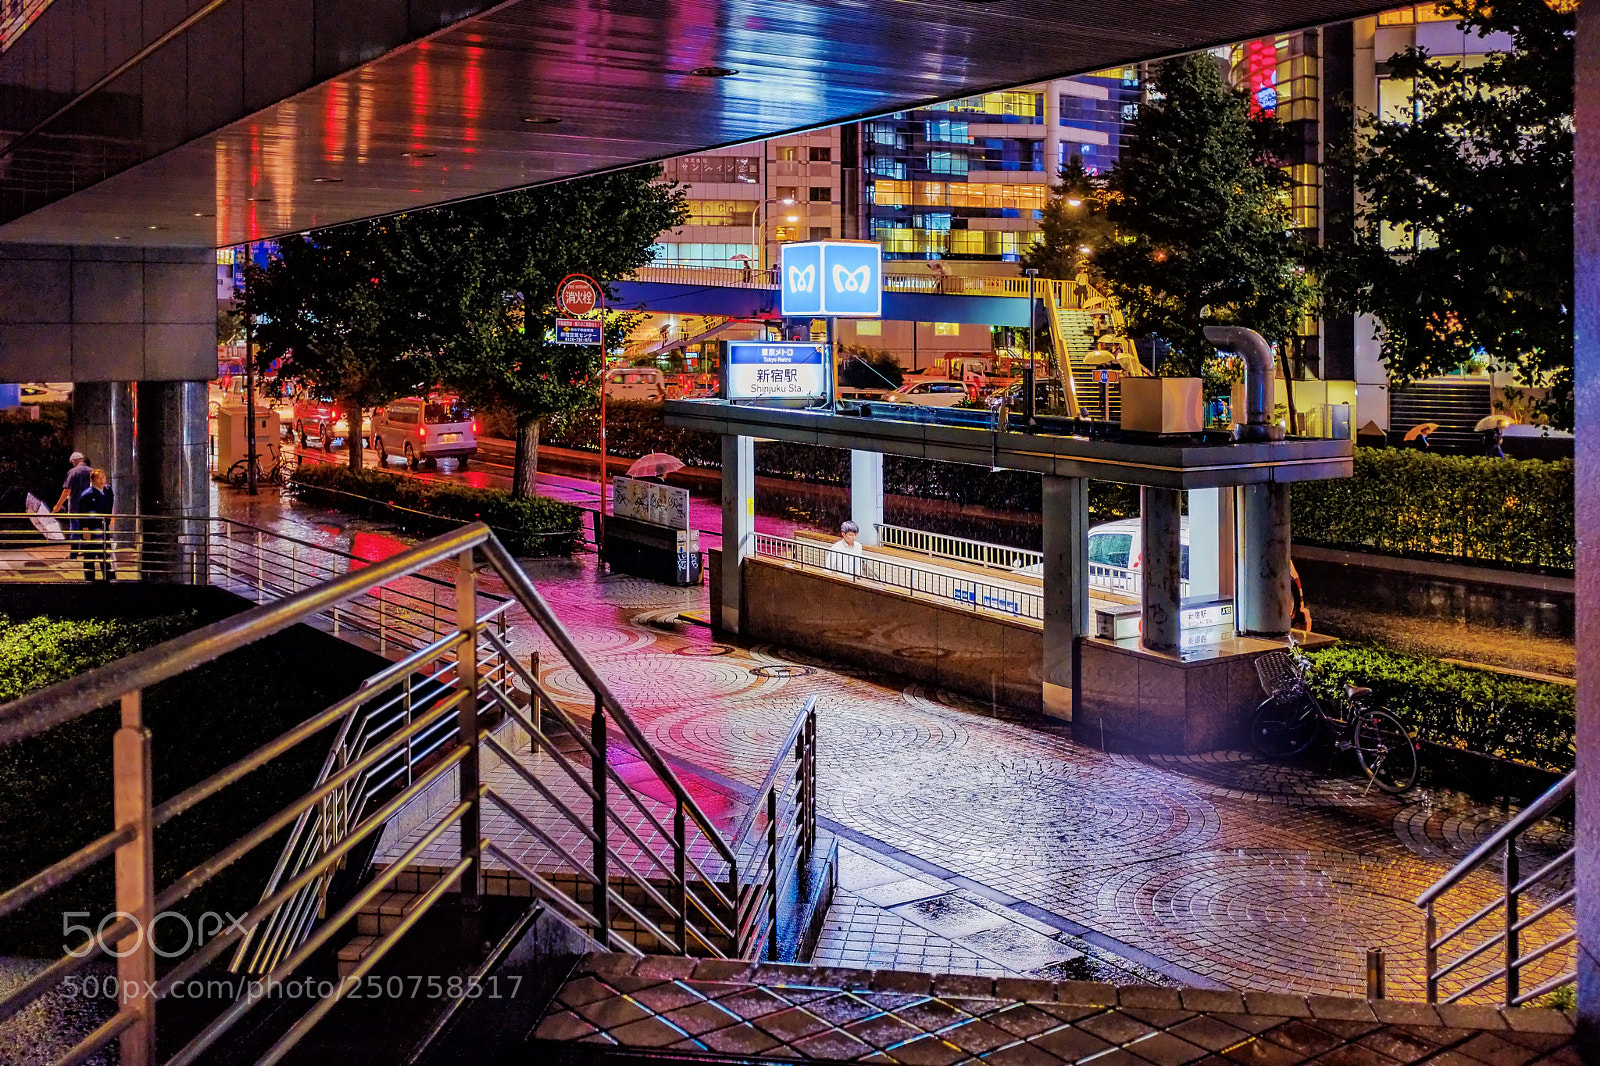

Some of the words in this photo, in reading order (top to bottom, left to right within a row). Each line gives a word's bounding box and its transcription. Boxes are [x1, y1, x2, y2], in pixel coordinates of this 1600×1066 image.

[565, 291, 593, 304] 消火栓
[761, 348, 794, 356] 東京メトロ
[763, 356, 778, 364] Tokyo
[756, 368, 798, 383] 新宿駅
[750, 383, 786, 394] Shinjuku
[788, 383, 804, 393] Sta.
